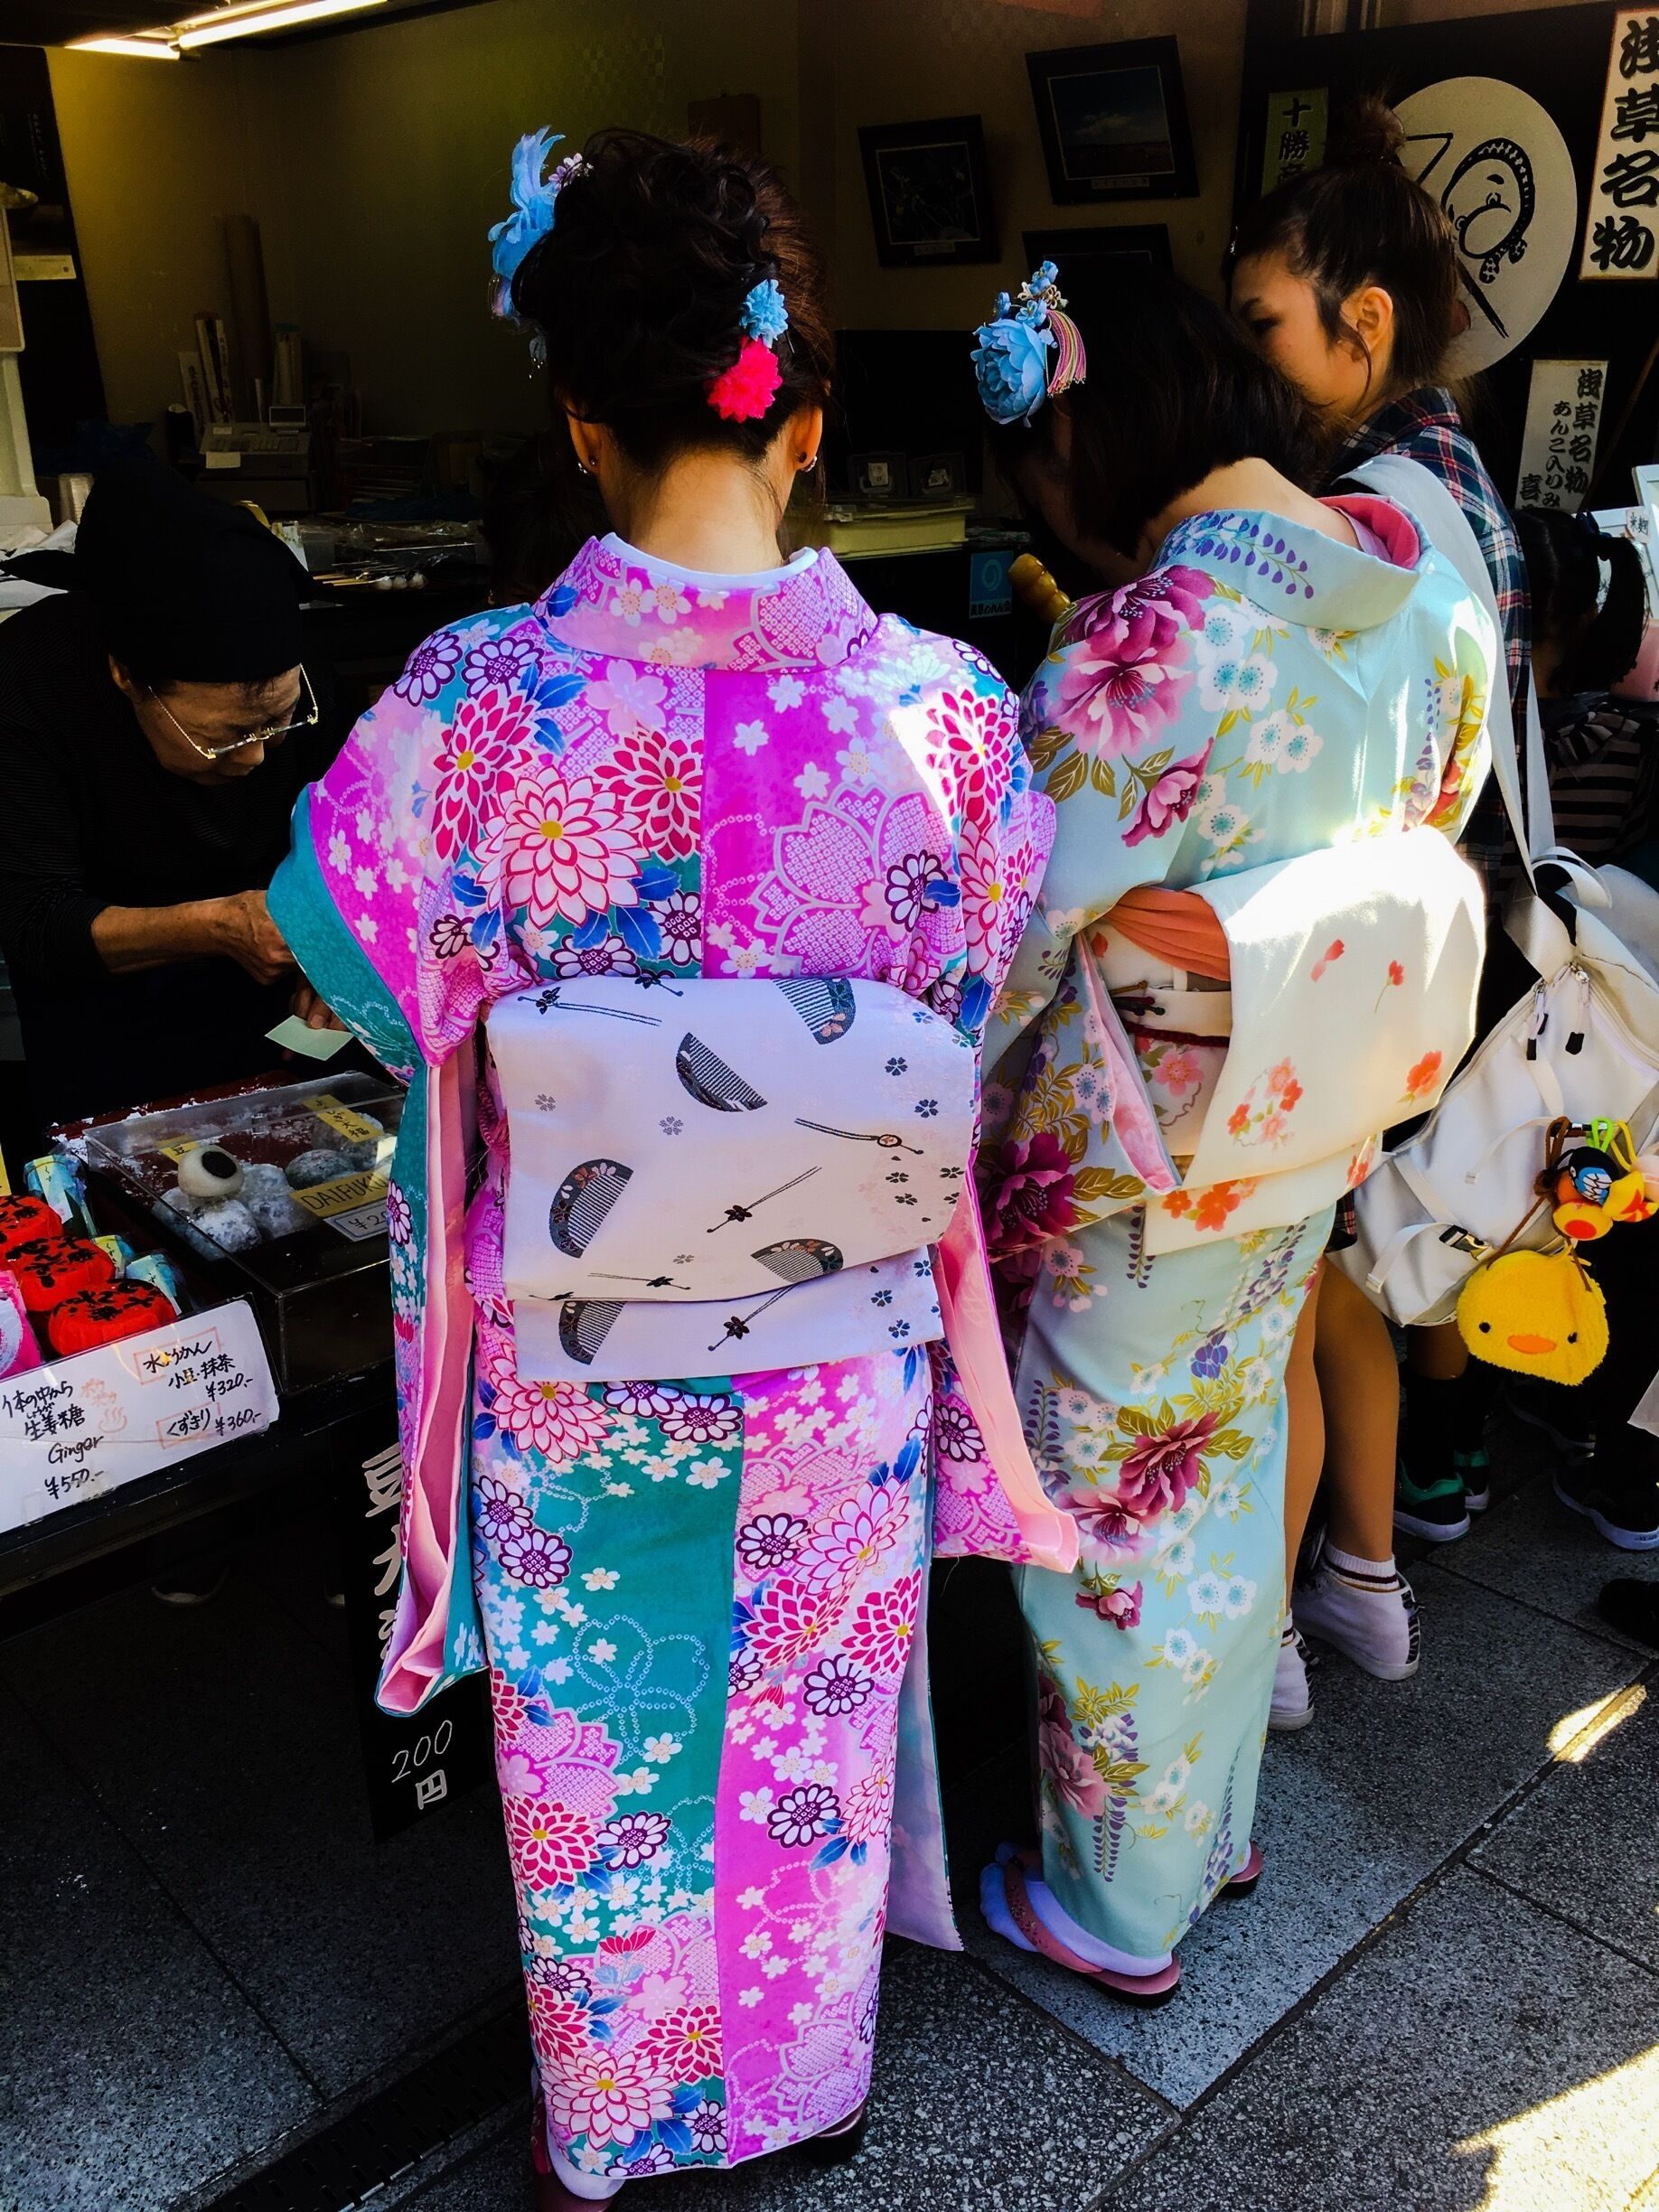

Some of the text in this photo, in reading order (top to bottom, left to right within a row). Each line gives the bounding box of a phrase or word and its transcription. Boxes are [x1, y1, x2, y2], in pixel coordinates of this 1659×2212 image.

[300, 1174, 389, 1210] DAIFUKU
[24, 1403, 85, 1441] 生姜糖
[167, 1408, 211, 1437] くずきり
[48, 1435, 104, 1465] Ginger
[391, 1720, 453, 1784] 200
[416, 1769, 448, 1811] 円
